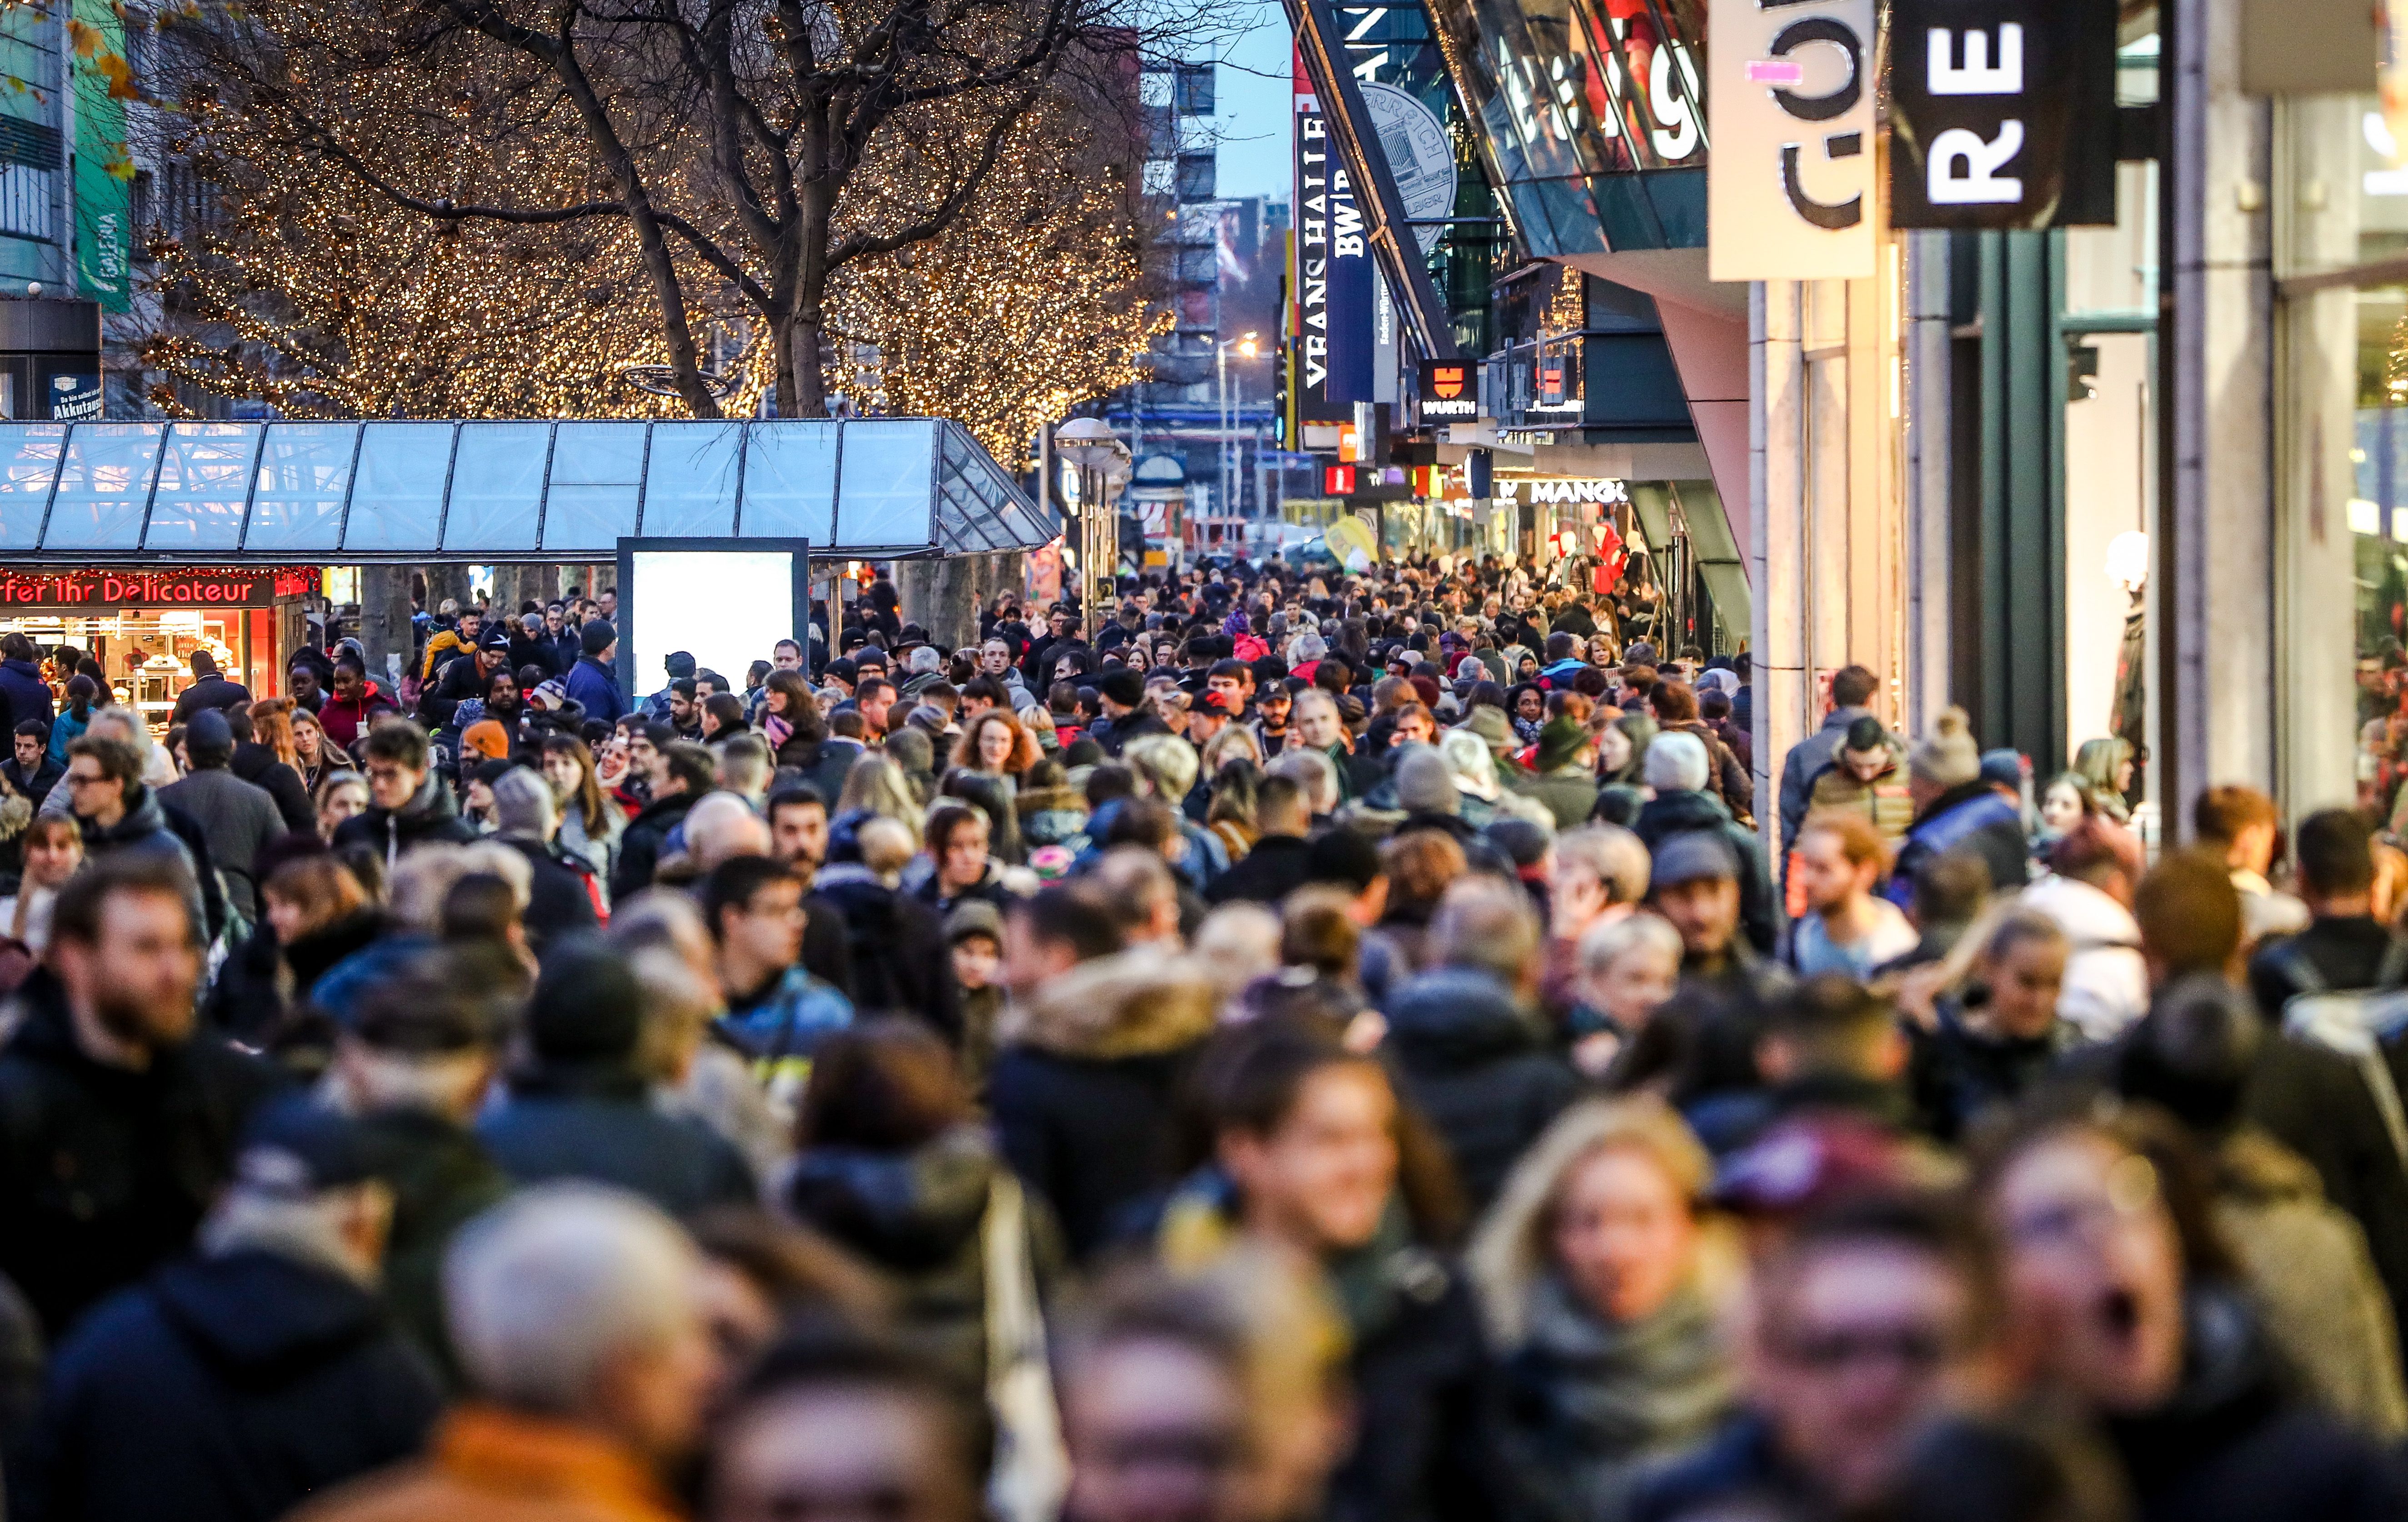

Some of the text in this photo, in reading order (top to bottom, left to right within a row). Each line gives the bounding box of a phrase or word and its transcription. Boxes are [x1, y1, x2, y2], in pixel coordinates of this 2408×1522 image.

[1379, 272, 1389, 345] Baden-Württe
[0, 579, 47, 603] fer
[56, 579, 95, 603] Ihr
[104, 578, 254, 602] Delicateur
